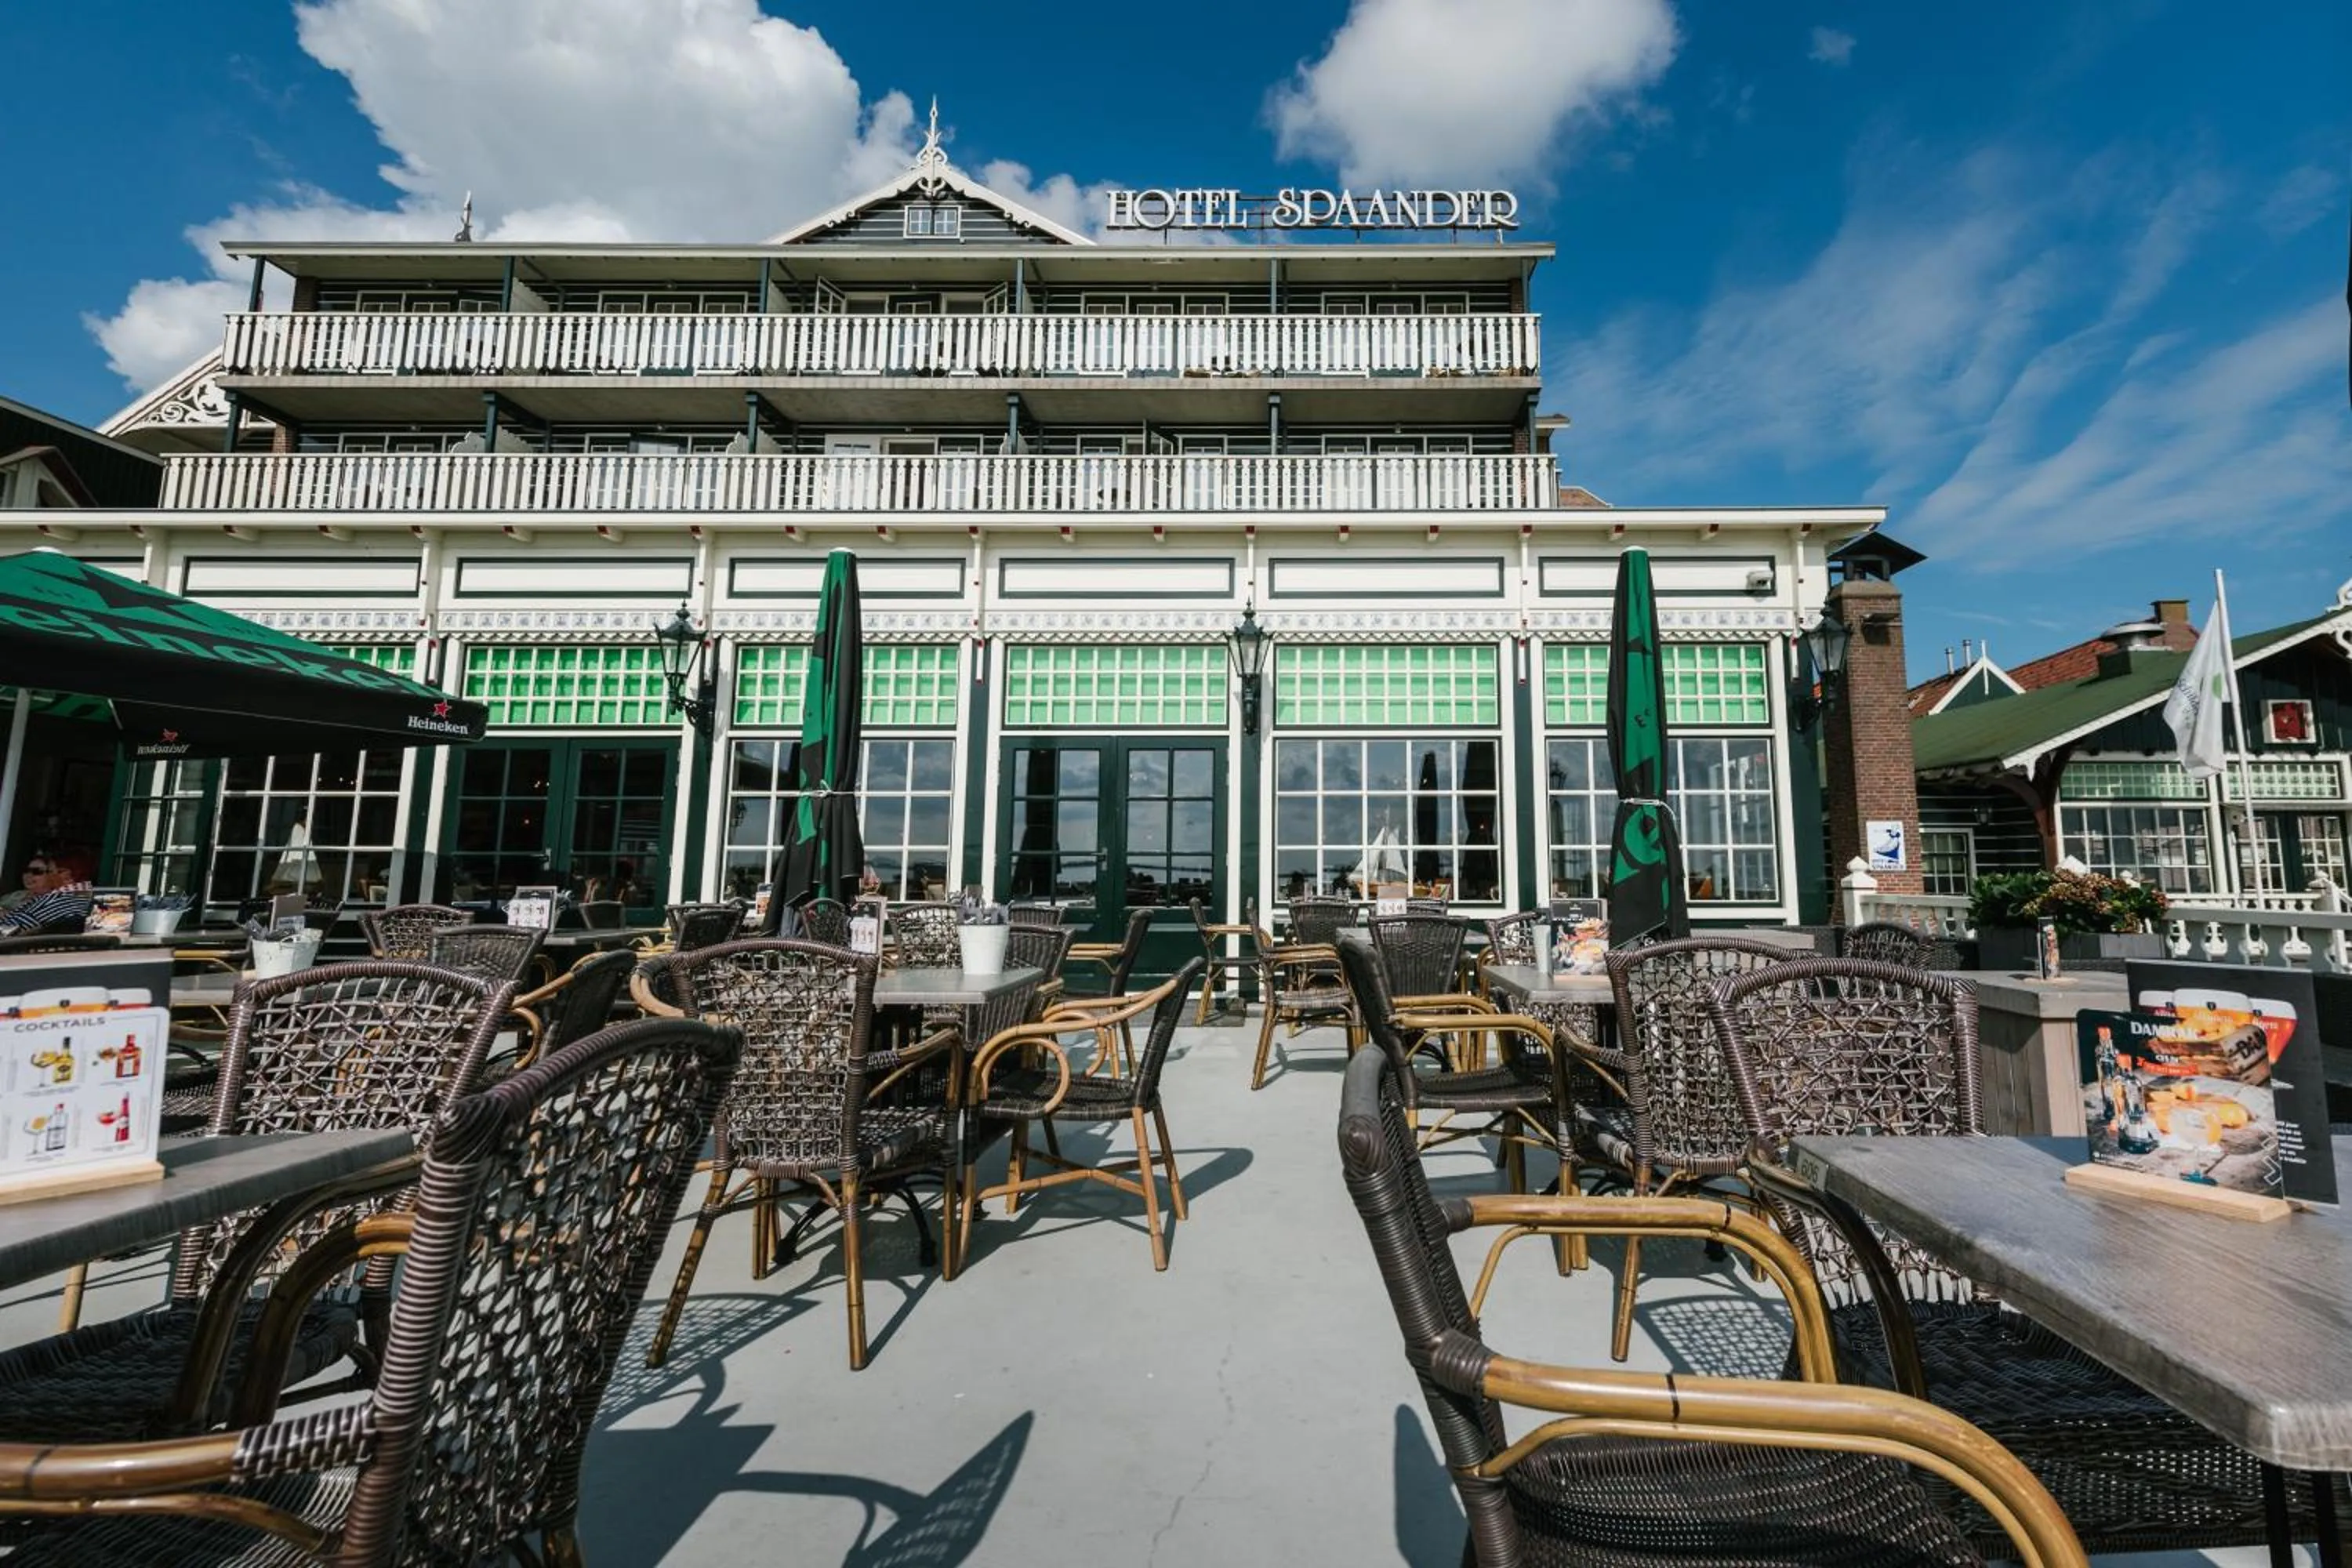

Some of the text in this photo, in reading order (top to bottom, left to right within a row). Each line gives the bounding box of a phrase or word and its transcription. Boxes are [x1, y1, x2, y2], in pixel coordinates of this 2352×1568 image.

[1106, 187, 1519, 229] HOTEL SPAANDER
[408, 714, 468, 735] Heineken
[14, 1017, 106, 1033] COCKTAILS
